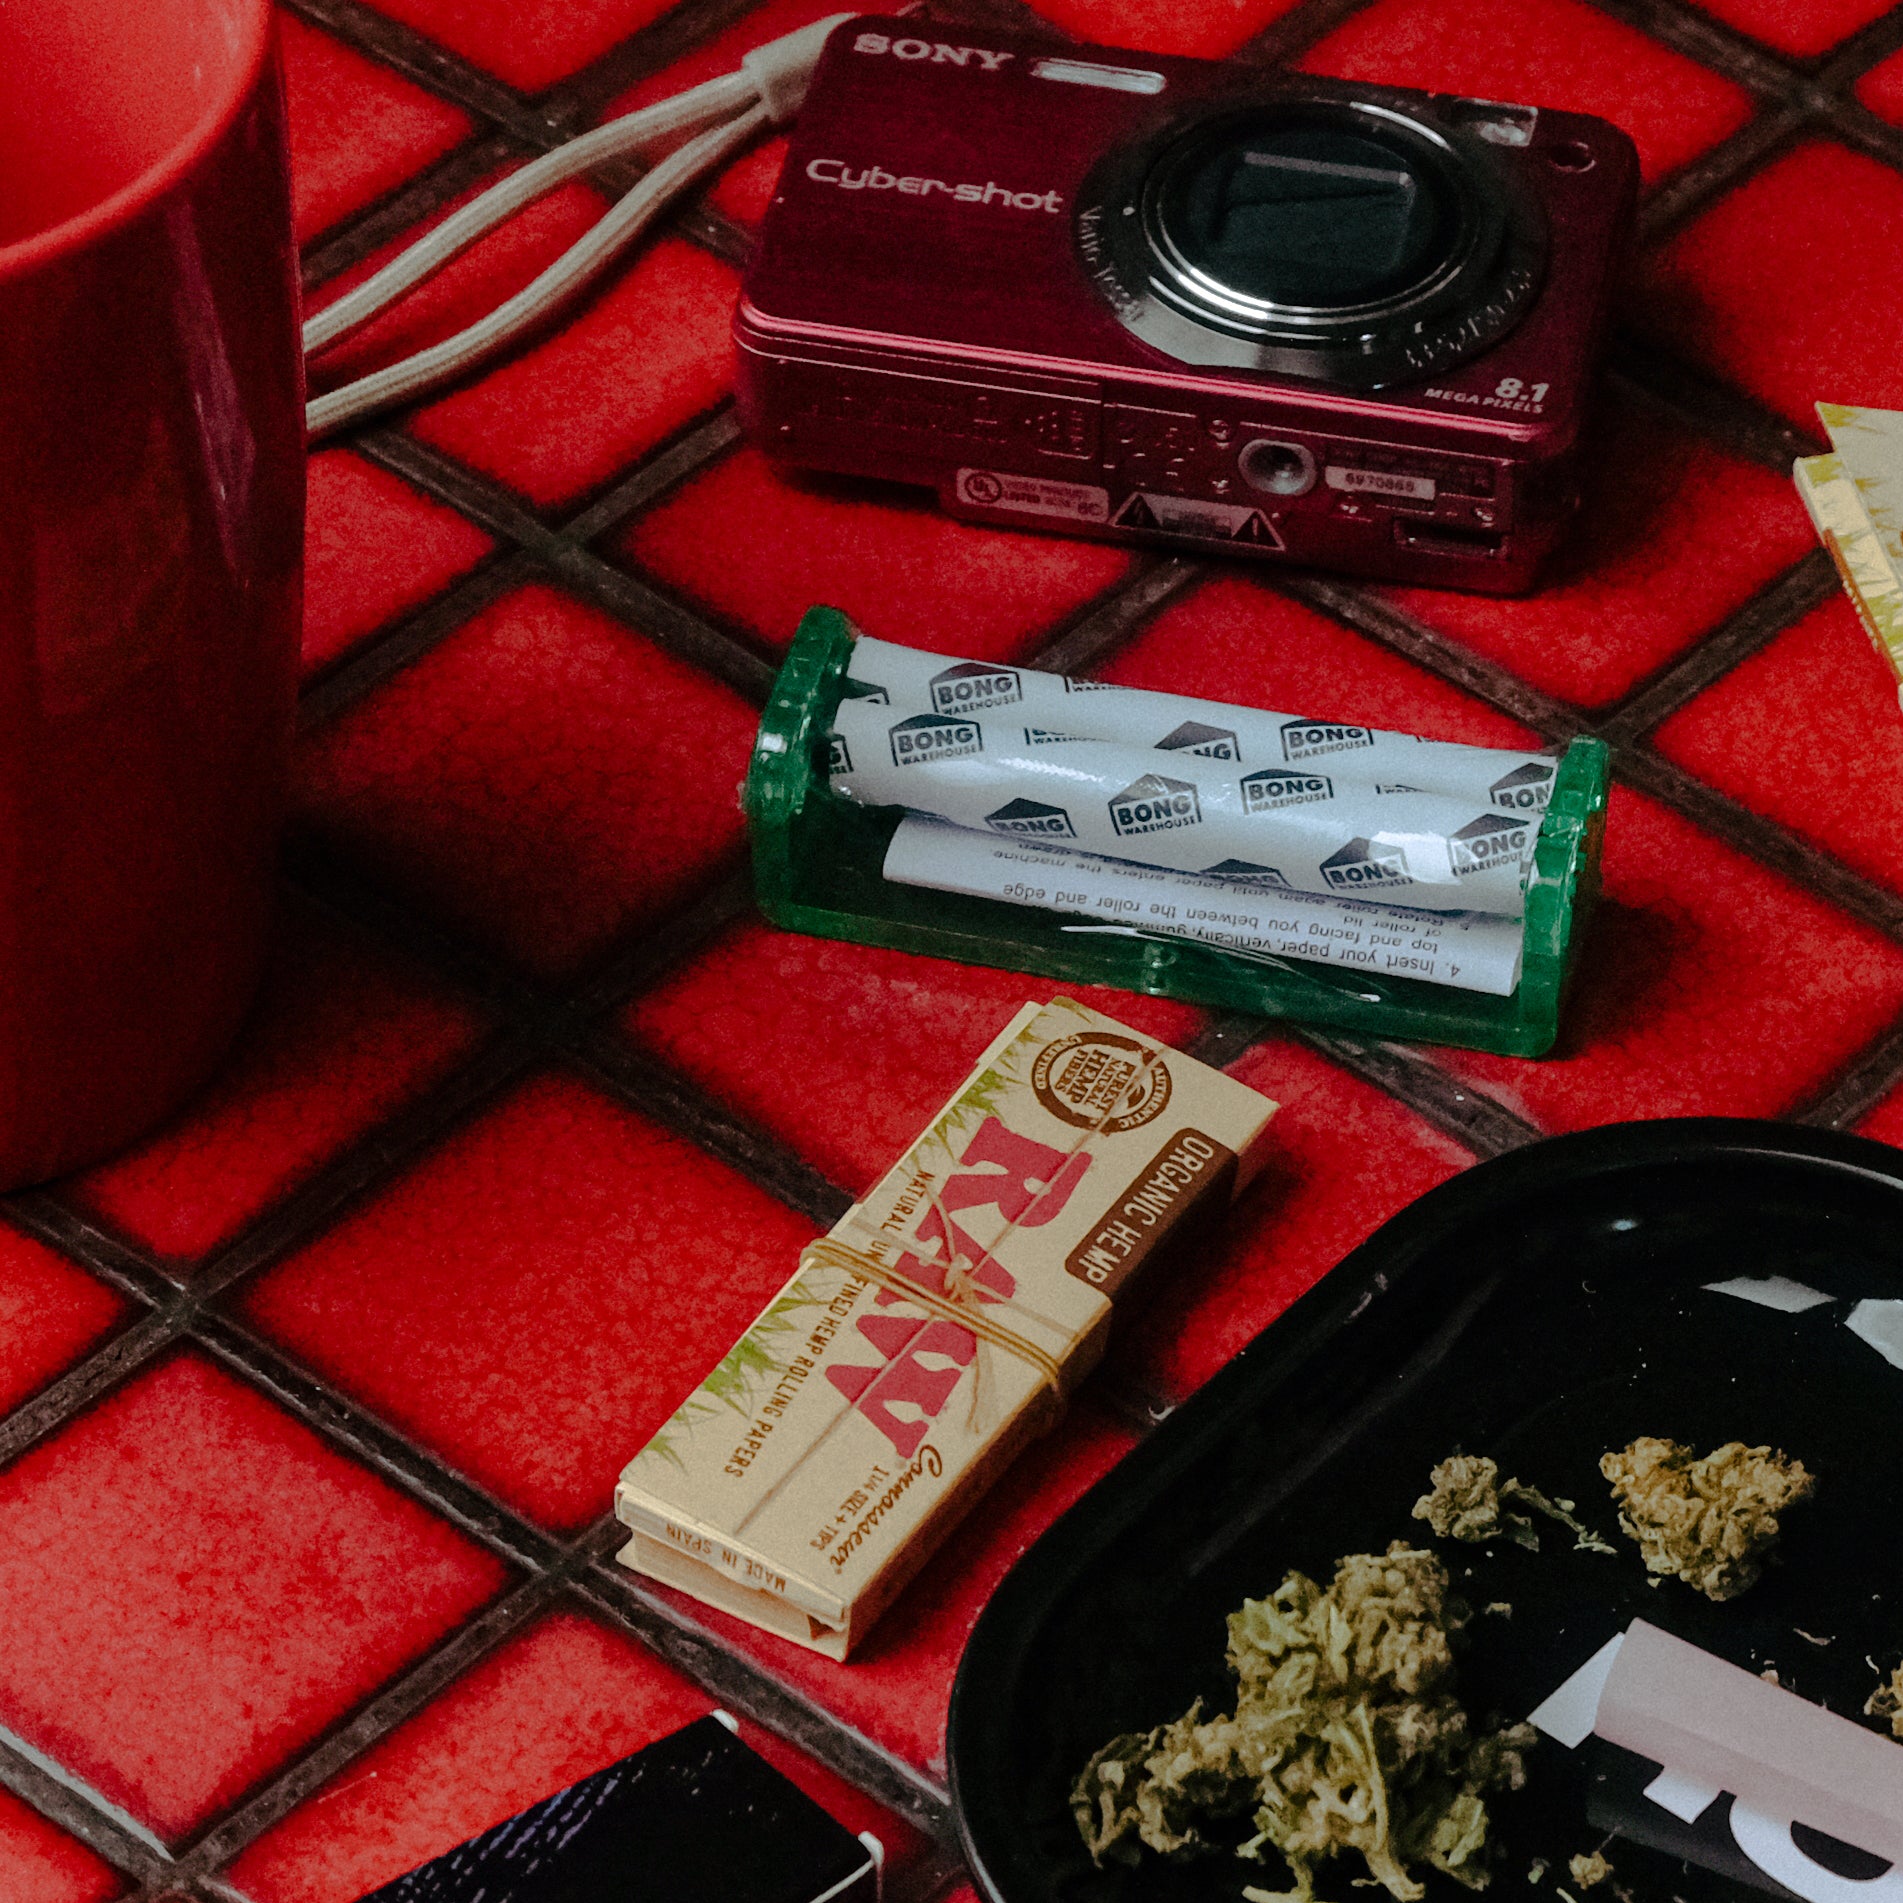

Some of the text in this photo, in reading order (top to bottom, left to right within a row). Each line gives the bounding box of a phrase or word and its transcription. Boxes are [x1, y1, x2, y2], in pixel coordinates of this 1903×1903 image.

[854, 33, 1014, 71] SONY
[805, 158, 1064, 215] Cyber-shot
[1495, 377, 1550, 402] 8.1
[936, 675, 1014, 705] BONG
[898, 726, 975, 753] BONG
[1288, 724, 1364, 748] BONG
[900, 744, 979, 766] WAREHOUSE
[1291, 739, 1369, 759] WAREHOUSE
[1249, 776, 1325, 799] BONG
[1118, 795, 1190, 827] BONG
[1249, 793, 1329, 812] WAREHOUSE
[1123, 815, 1196, 835] WAREHOUSE
[1075, 861, 1101, 874] the
[1112, 867, 1166, 882] enters
[1174, 876, 1225, 891] paper
[1003, 884, 1438, 954] top and facing you between the roller and edge
[1343, 915, 1442, 938] of roller lid
[1277, 938, 1330, 957] paper,
[1339, 950, 1377, 966] your
[1386, 953, 1434, 975] Insert
[1445, 962, 1461, 978] 4.
[1055, 1048, 1089, 1093] FIBERS
[1066, 1048, 1111, 1104] HEMP
[1118, 1067, 1167, 1129] AUTHENTIC
[1078, 1135, 1215, 1285] ORGANIC HEMP
[825, 1116, 1094, 1459] RAW
[724, 1168, 936, 1479] NATURAL UNFINED HEMP ROLLING PAPERS
[829, 1443, 943, 1567] Connoisseur
[665, 1522, 787, 1593] MADE IN SPAIN
